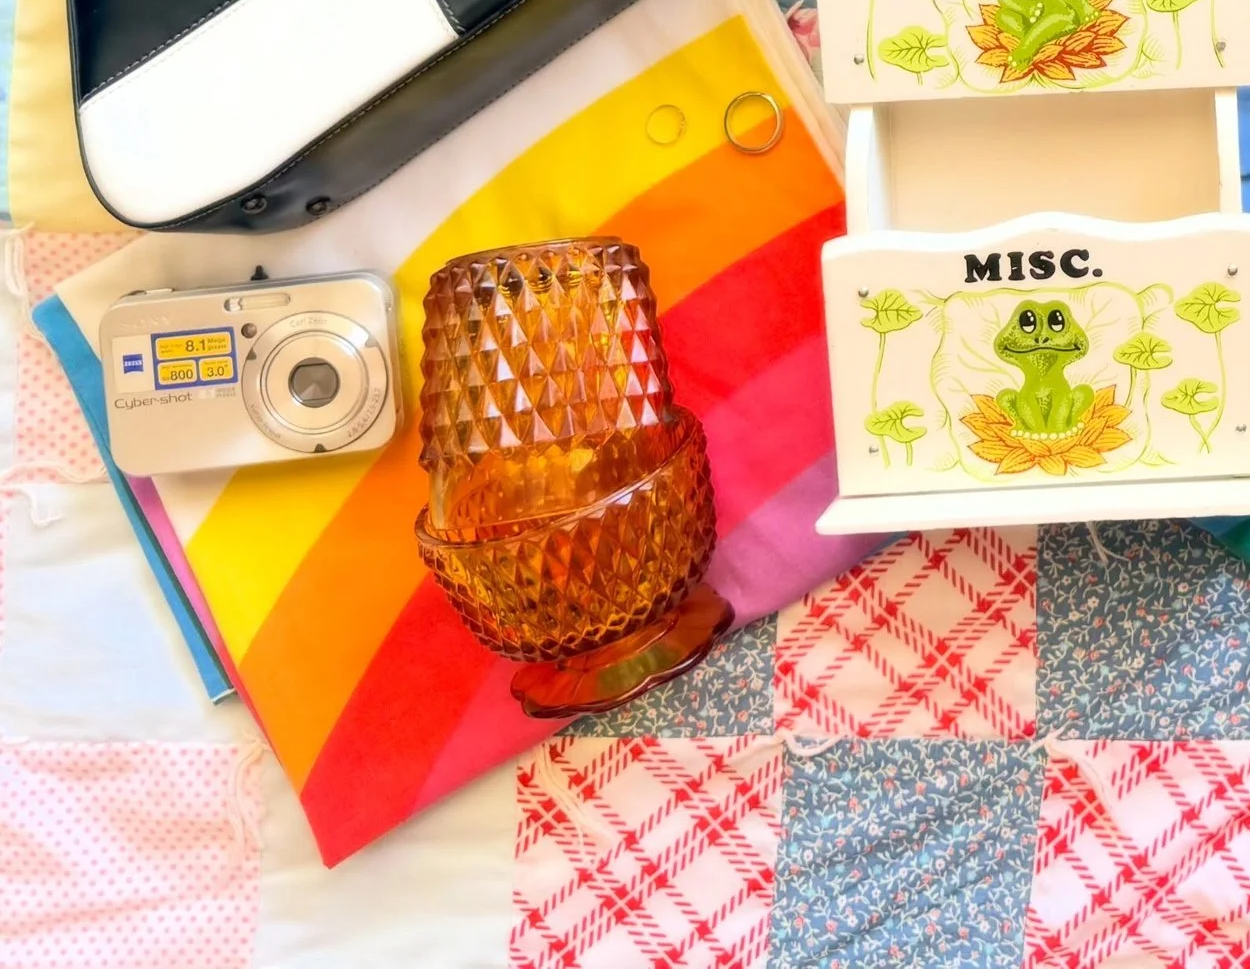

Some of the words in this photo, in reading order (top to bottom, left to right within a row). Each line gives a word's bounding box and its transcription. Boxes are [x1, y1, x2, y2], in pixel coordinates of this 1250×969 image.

[964, 248, 1103, 283] MISC.
[185, 339, 206, 353] 8.1
[170, 369, 194, 381] 800
[114, 392, 193, 410] Cyber-shot
